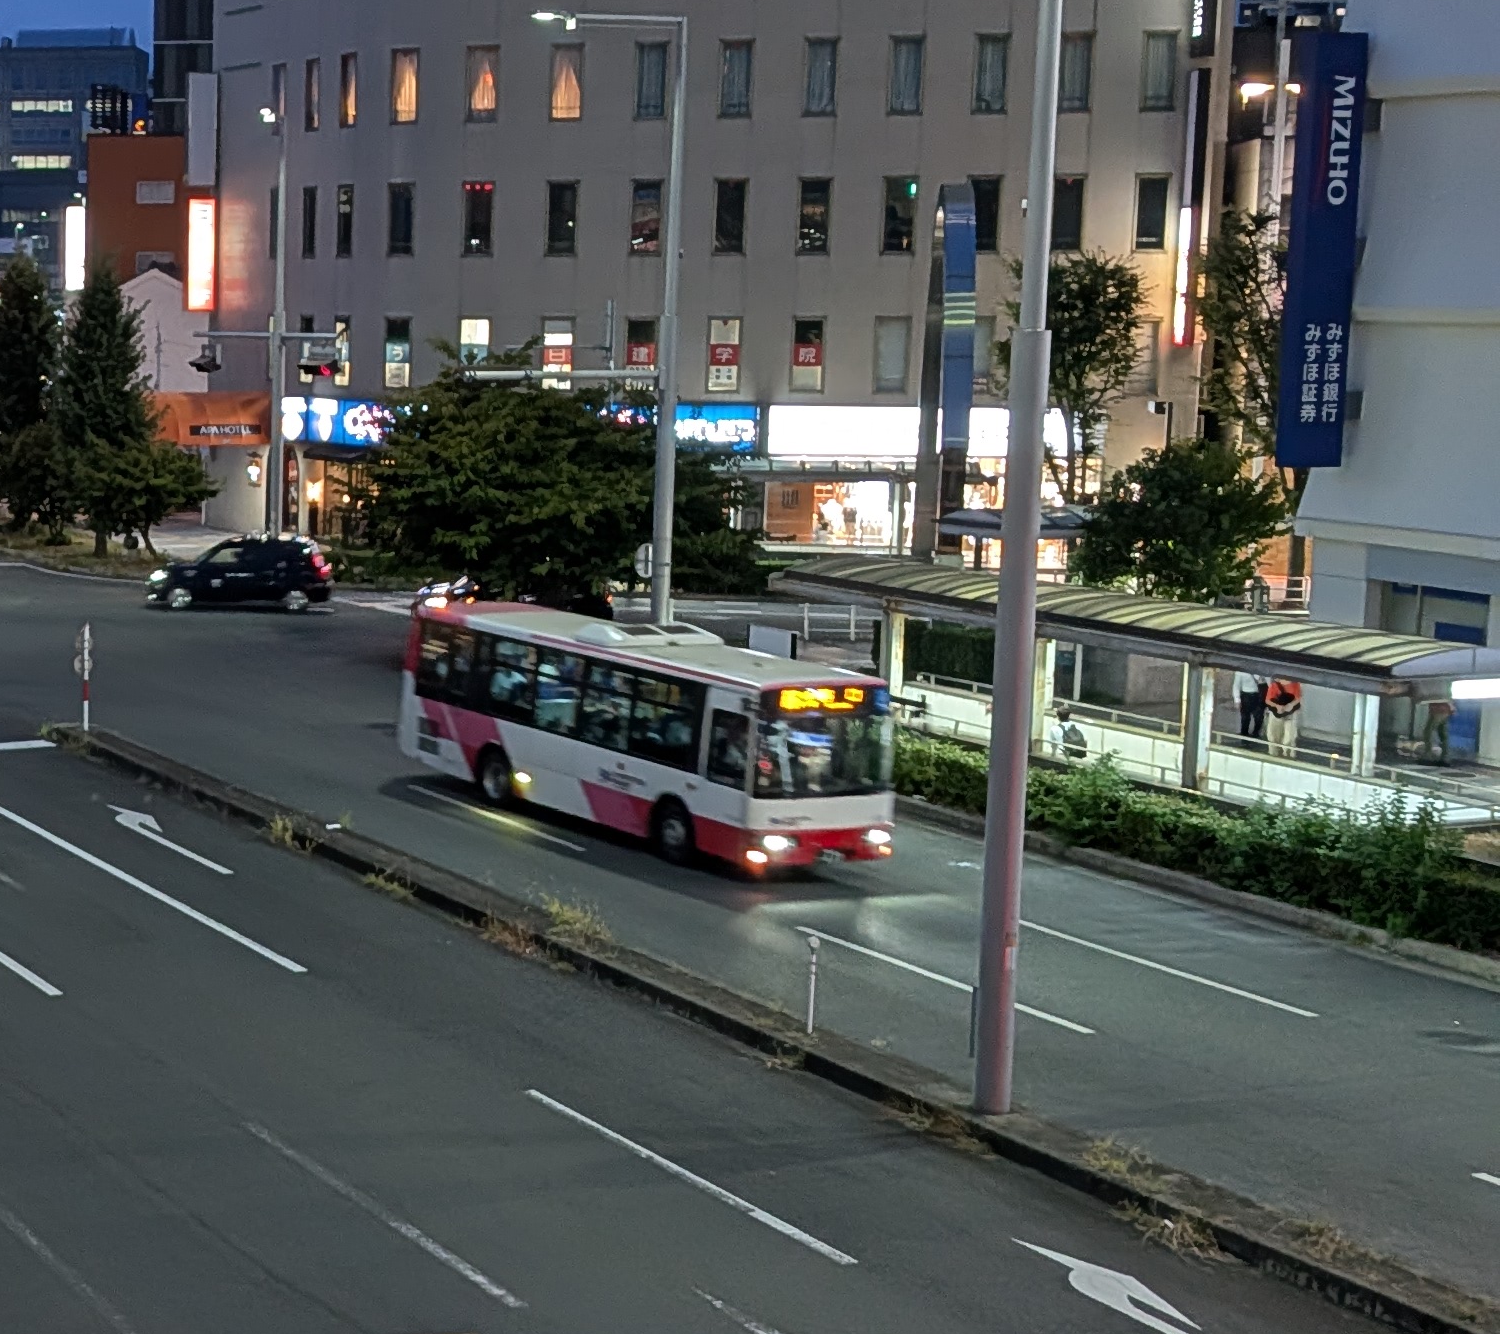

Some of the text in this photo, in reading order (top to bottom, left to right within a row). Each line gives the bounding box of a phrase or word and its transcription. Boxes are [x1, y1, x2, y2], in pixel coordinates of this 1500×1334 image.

[1326, 74, 1357, 206] MIZUHO
[1299, 322, 1323, 424] みずほ証券
[1320, 322, 1343, 423] みずほ銀行
